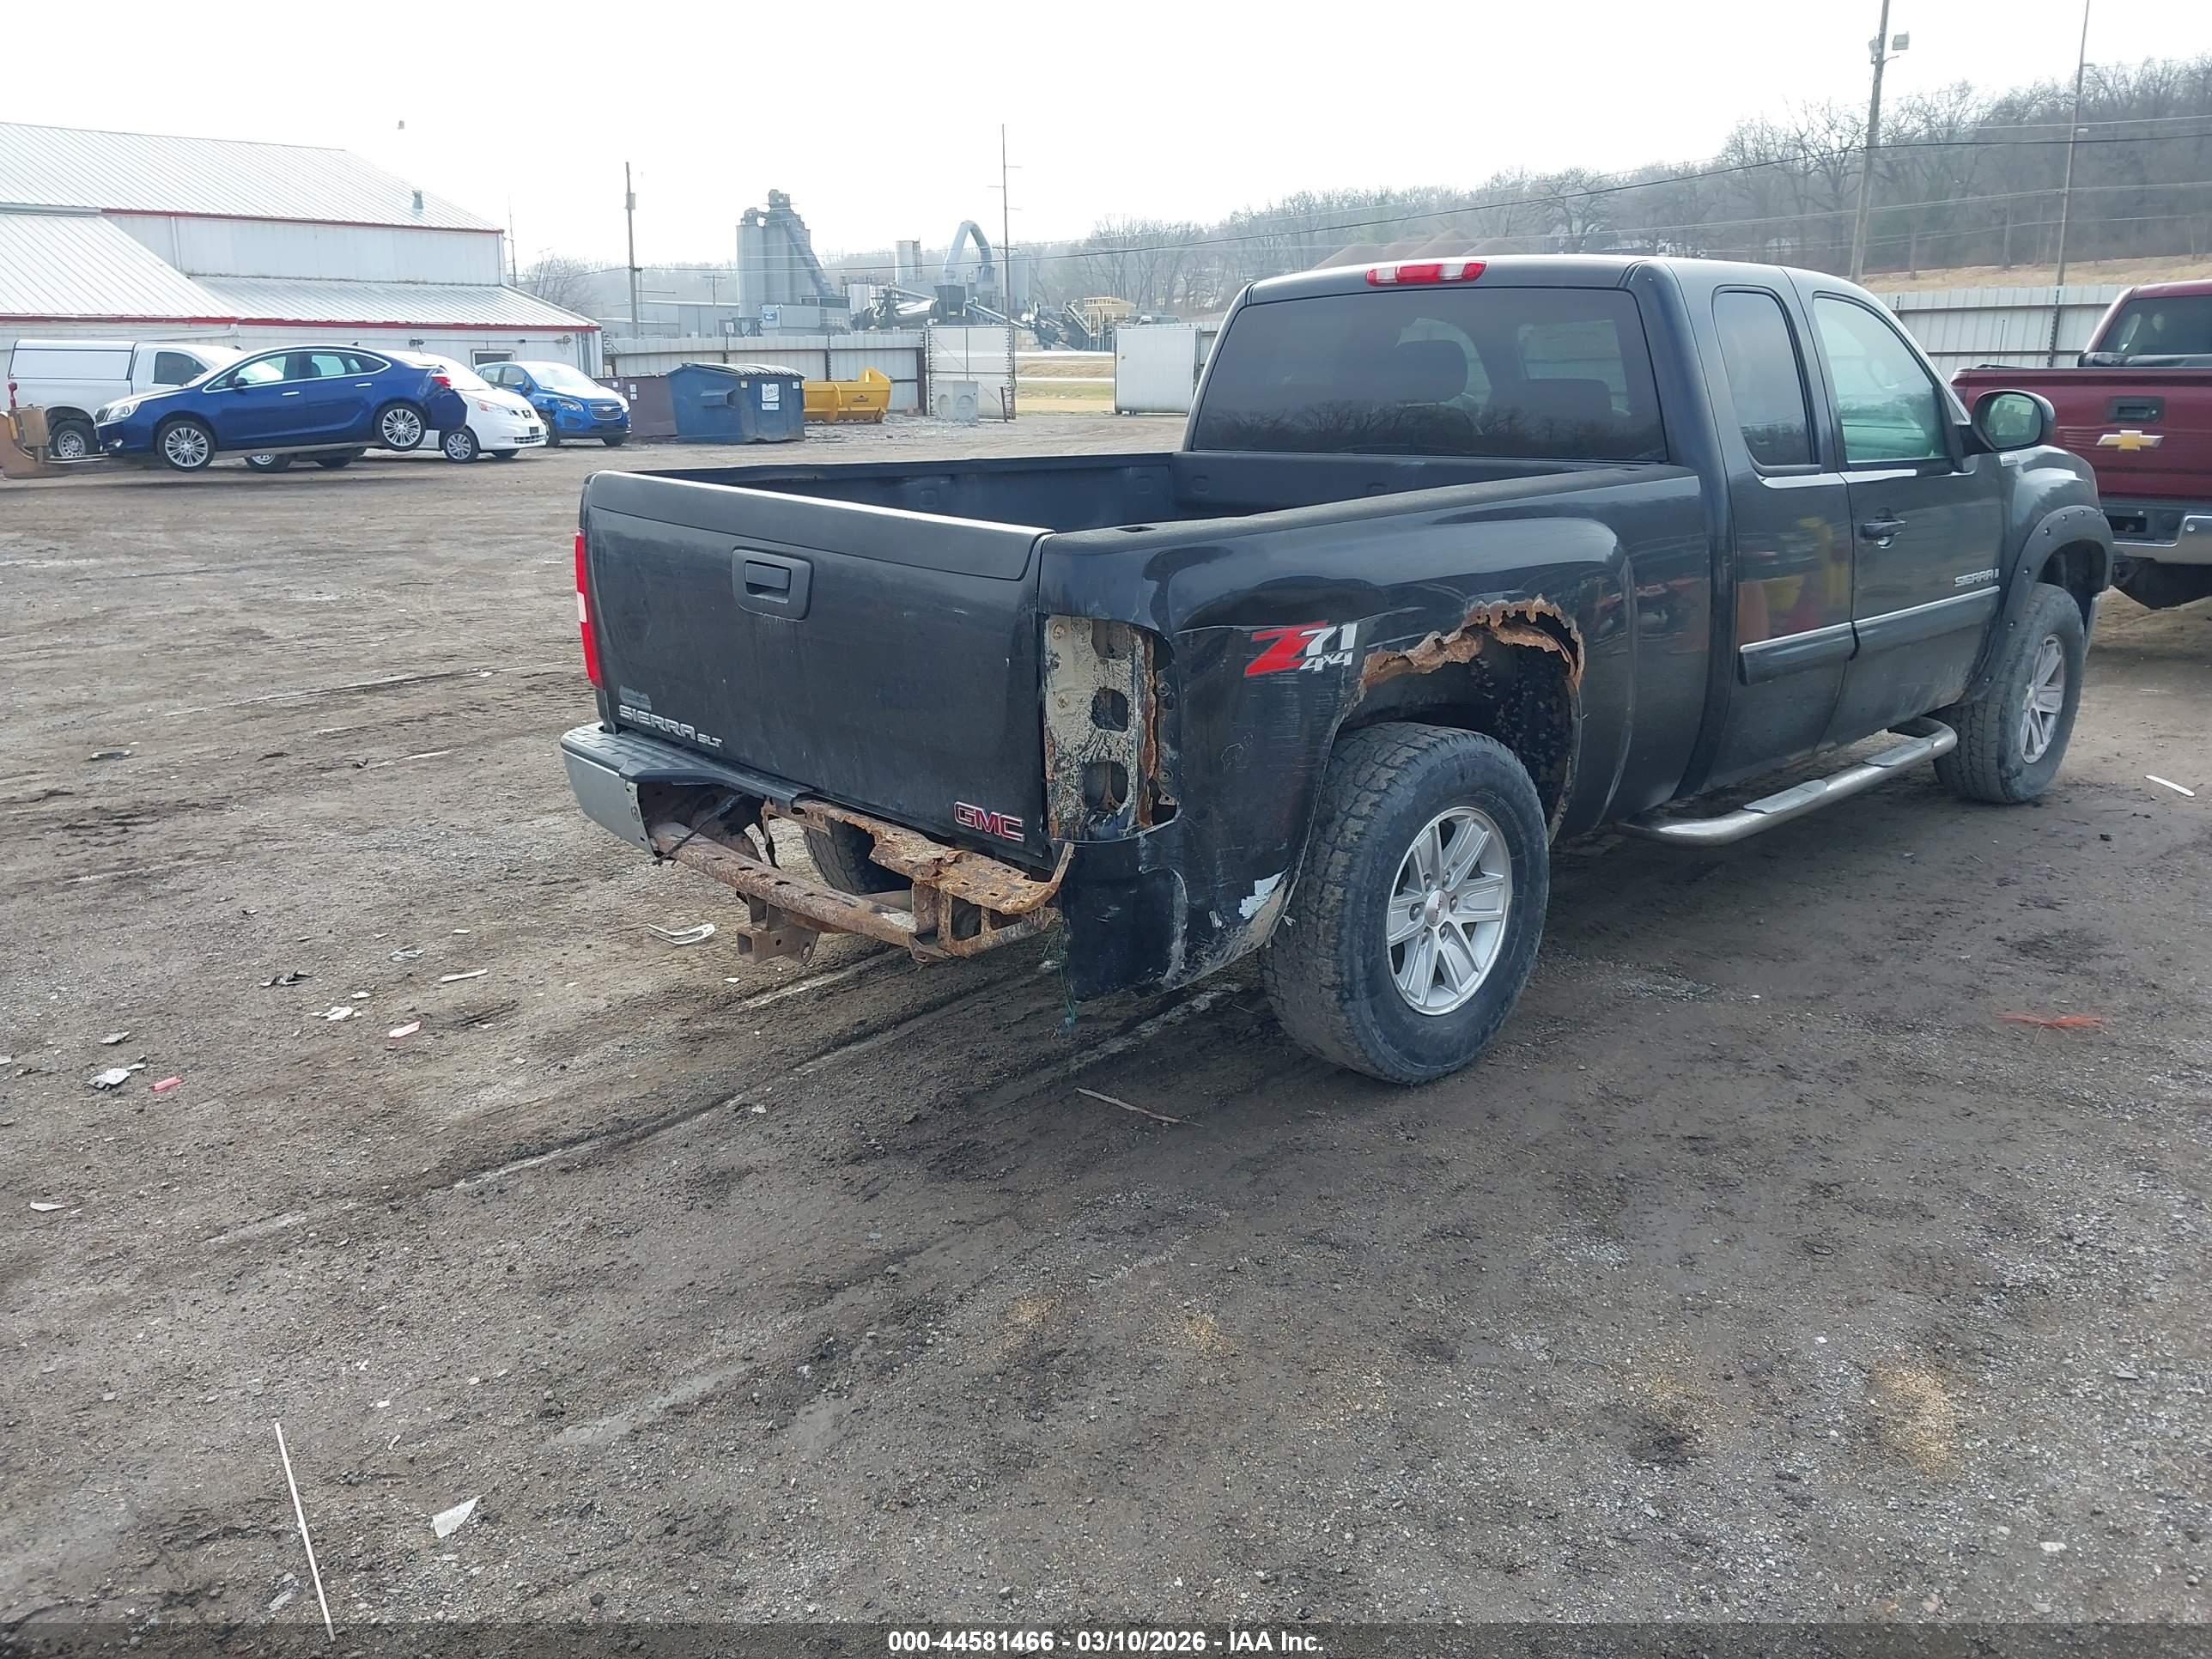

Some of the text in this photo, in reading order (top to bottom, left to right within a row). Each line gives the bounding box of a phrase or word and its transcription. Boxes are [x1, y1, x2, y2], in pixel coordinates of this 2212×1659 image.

[1243, 620, 1357, 678] Z71
[619, 704, 722, 747] SIERRA SLT
[954, 801, 1025, 842] GMC
